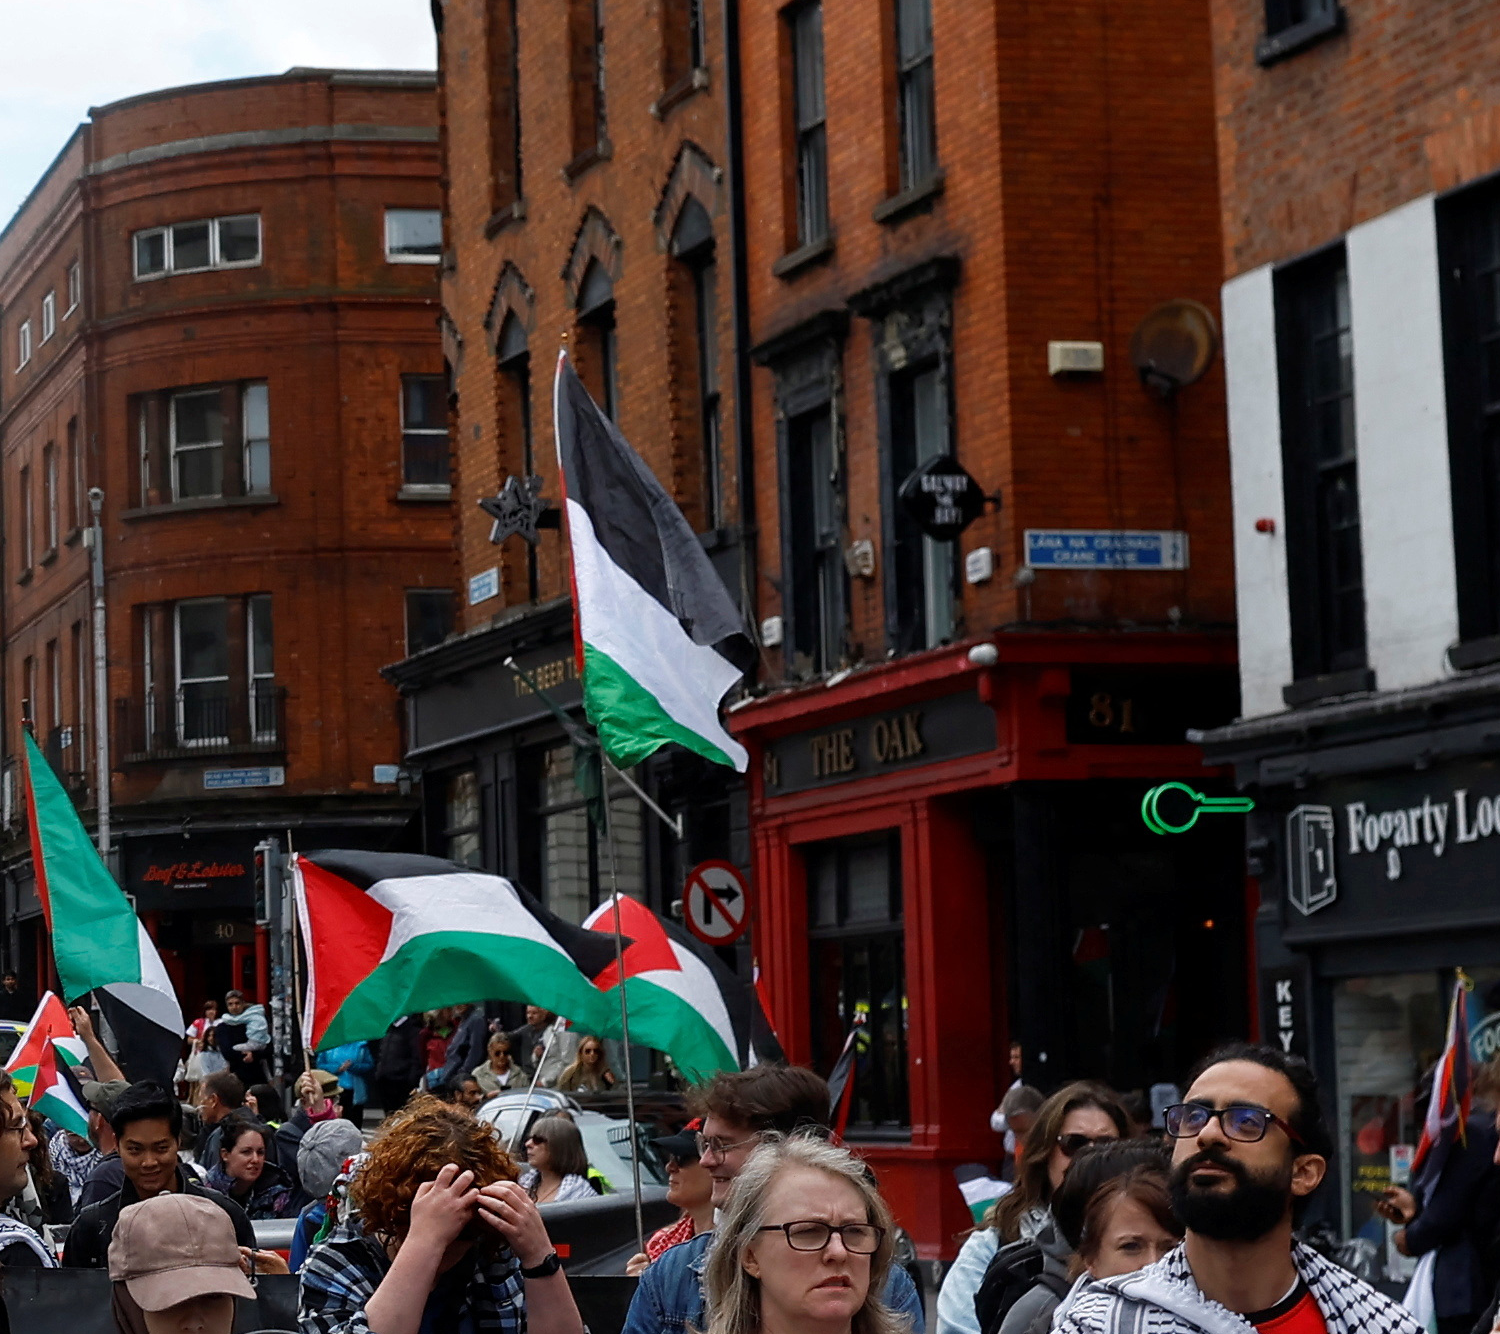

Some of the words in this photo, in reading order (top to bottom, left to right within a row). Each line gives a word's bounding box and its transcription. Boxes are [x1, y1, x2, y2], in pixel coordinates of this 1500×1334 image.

[1052, 550, 1097, 563] CRANE
[1088, 691, 1135, 734] 81
[811, 728, 856, 777] THE
[872, 712, 924, 763] OAK
[1346, 796, 1449, 880] Fogarty
[215, 922, 234, 939] 40
